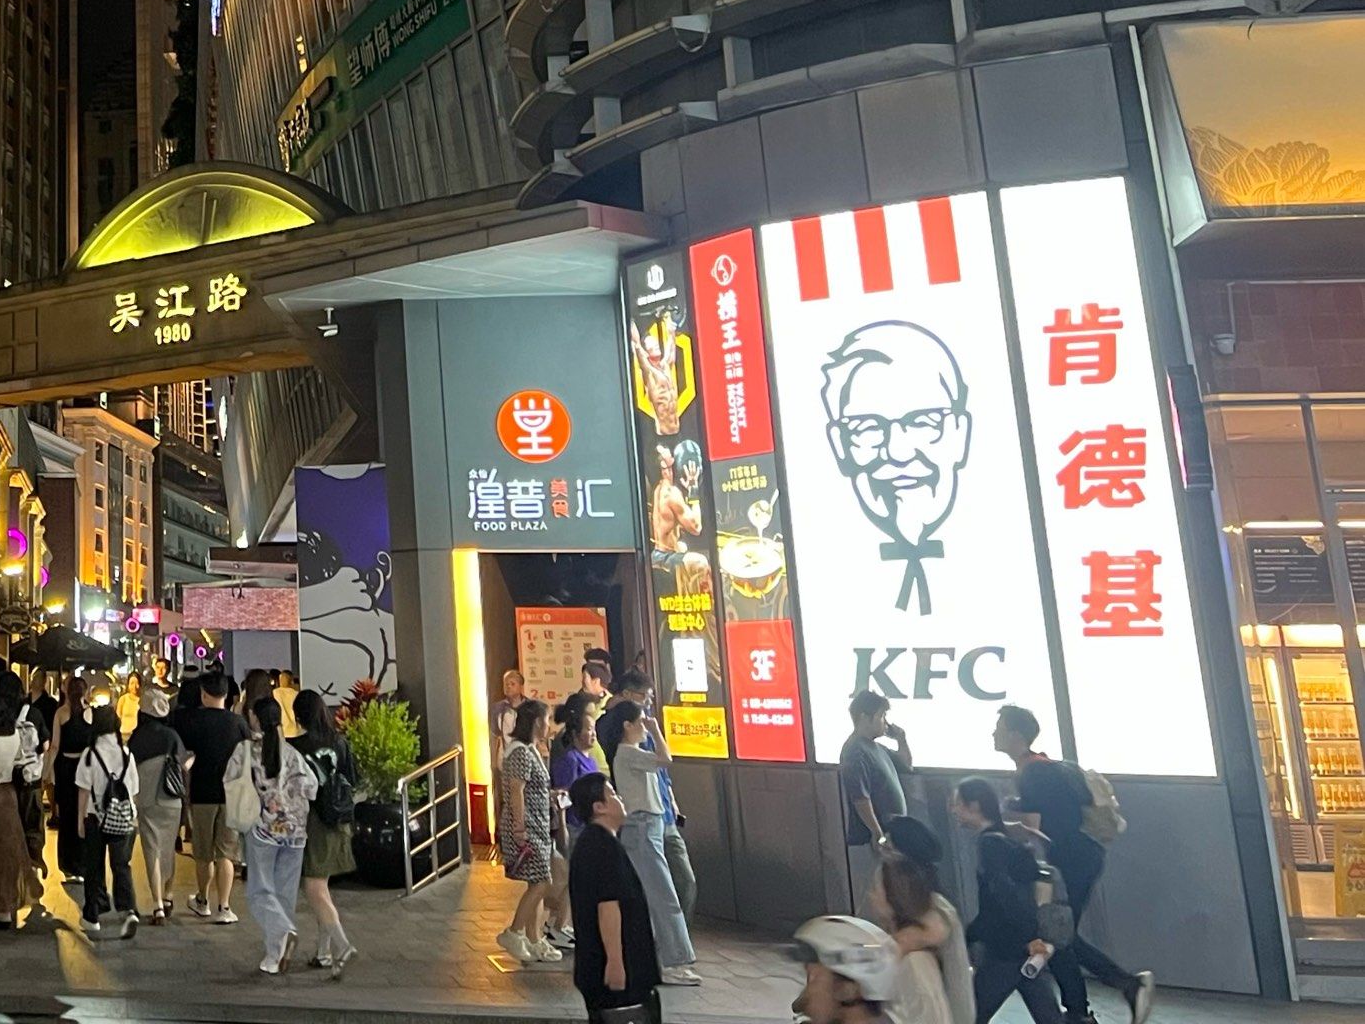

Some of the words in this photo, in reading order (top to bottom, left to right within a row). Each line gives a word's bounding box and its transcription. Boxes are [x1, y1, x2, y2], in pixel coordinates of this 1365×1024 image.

[392, 18, 415, 49] WONG
[415, 1, 438, 31] SHIFU
[109, 273, 247, 333] 吴江路
[154, 322, 191, 345] 1980
[1043, 303, 1164, 637] 肯德基
[474, 521, 507, 531] FOOD
[511, 521, 548, 531] PLAZA
[750, 649, 776, 681] 3F
[849, 646, 1007, 700] KFC
